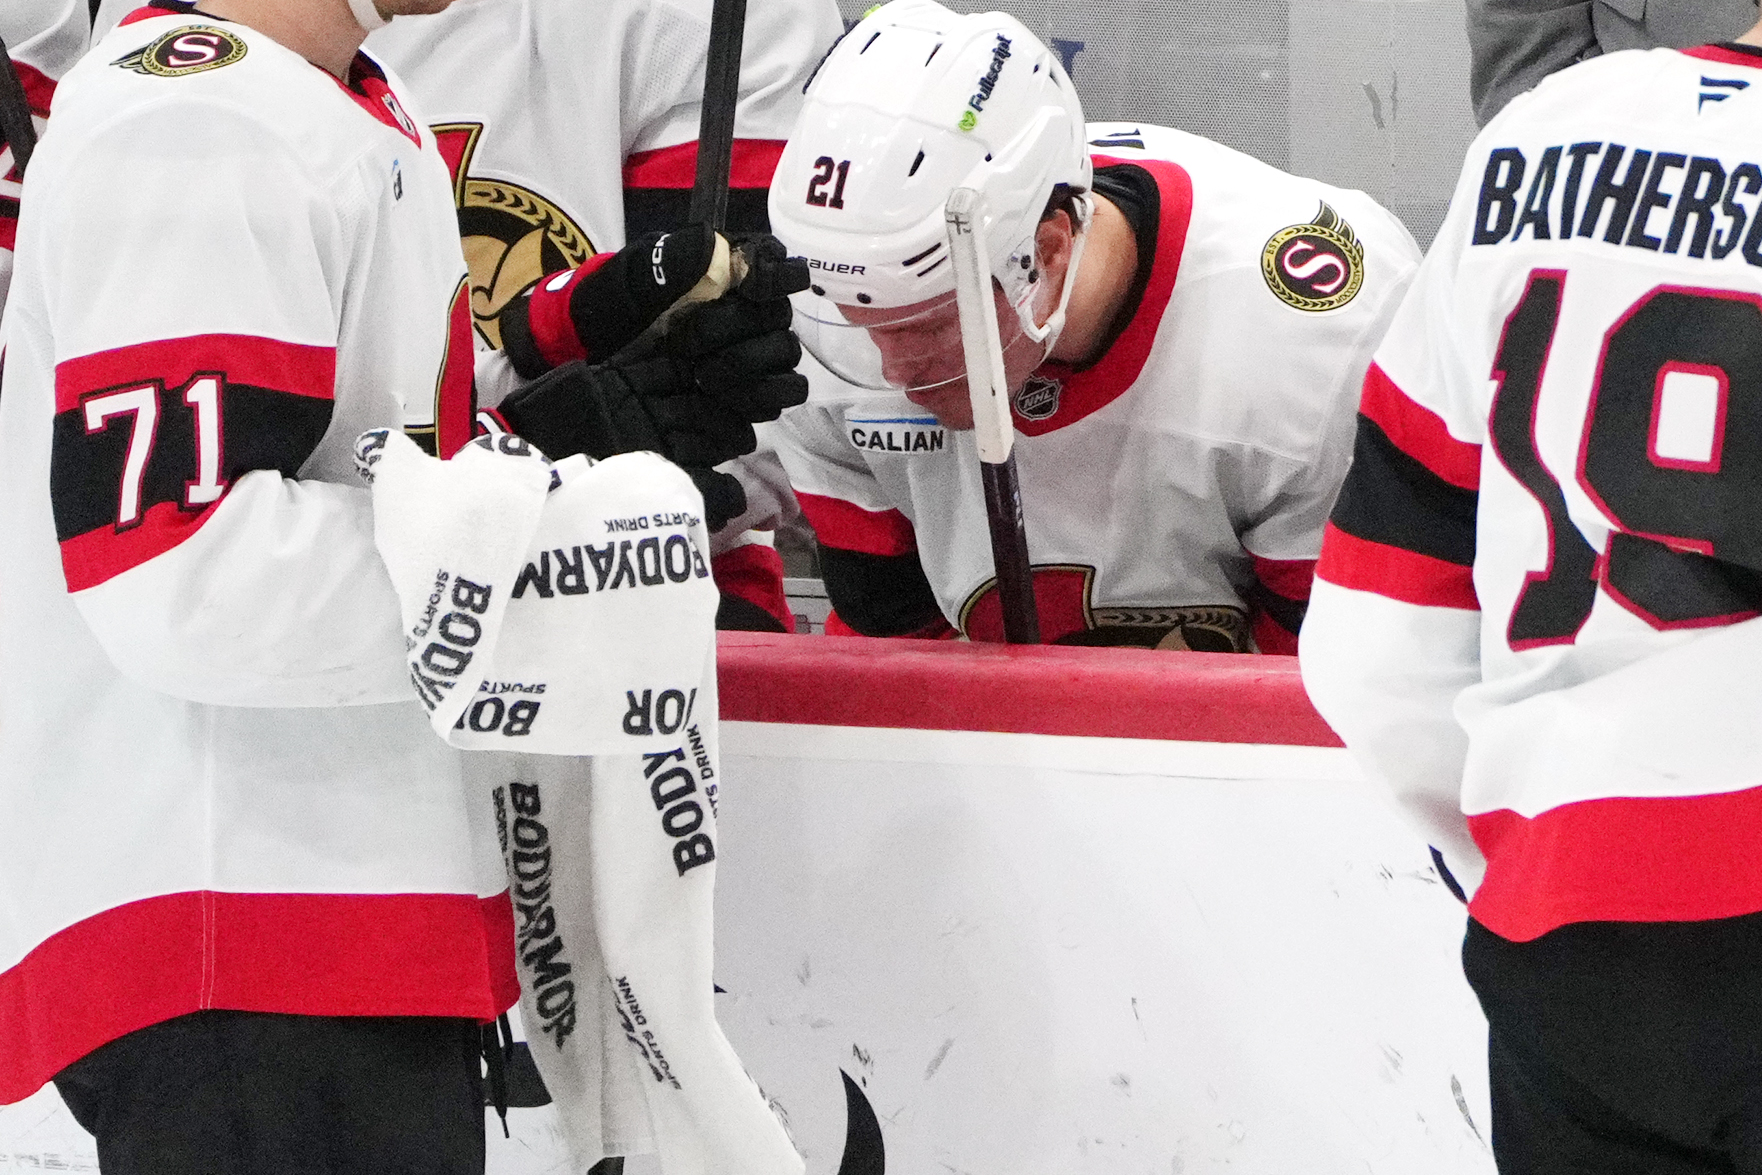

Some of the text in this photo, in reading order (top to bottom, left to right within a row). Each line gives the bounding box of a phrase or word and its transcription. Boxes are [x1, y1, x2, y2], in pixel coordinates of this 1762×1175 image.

[806, 155, 851, 210] 21
[78, 371, 228, 534] 71
[851, 427, 944, 453] CALIAN
